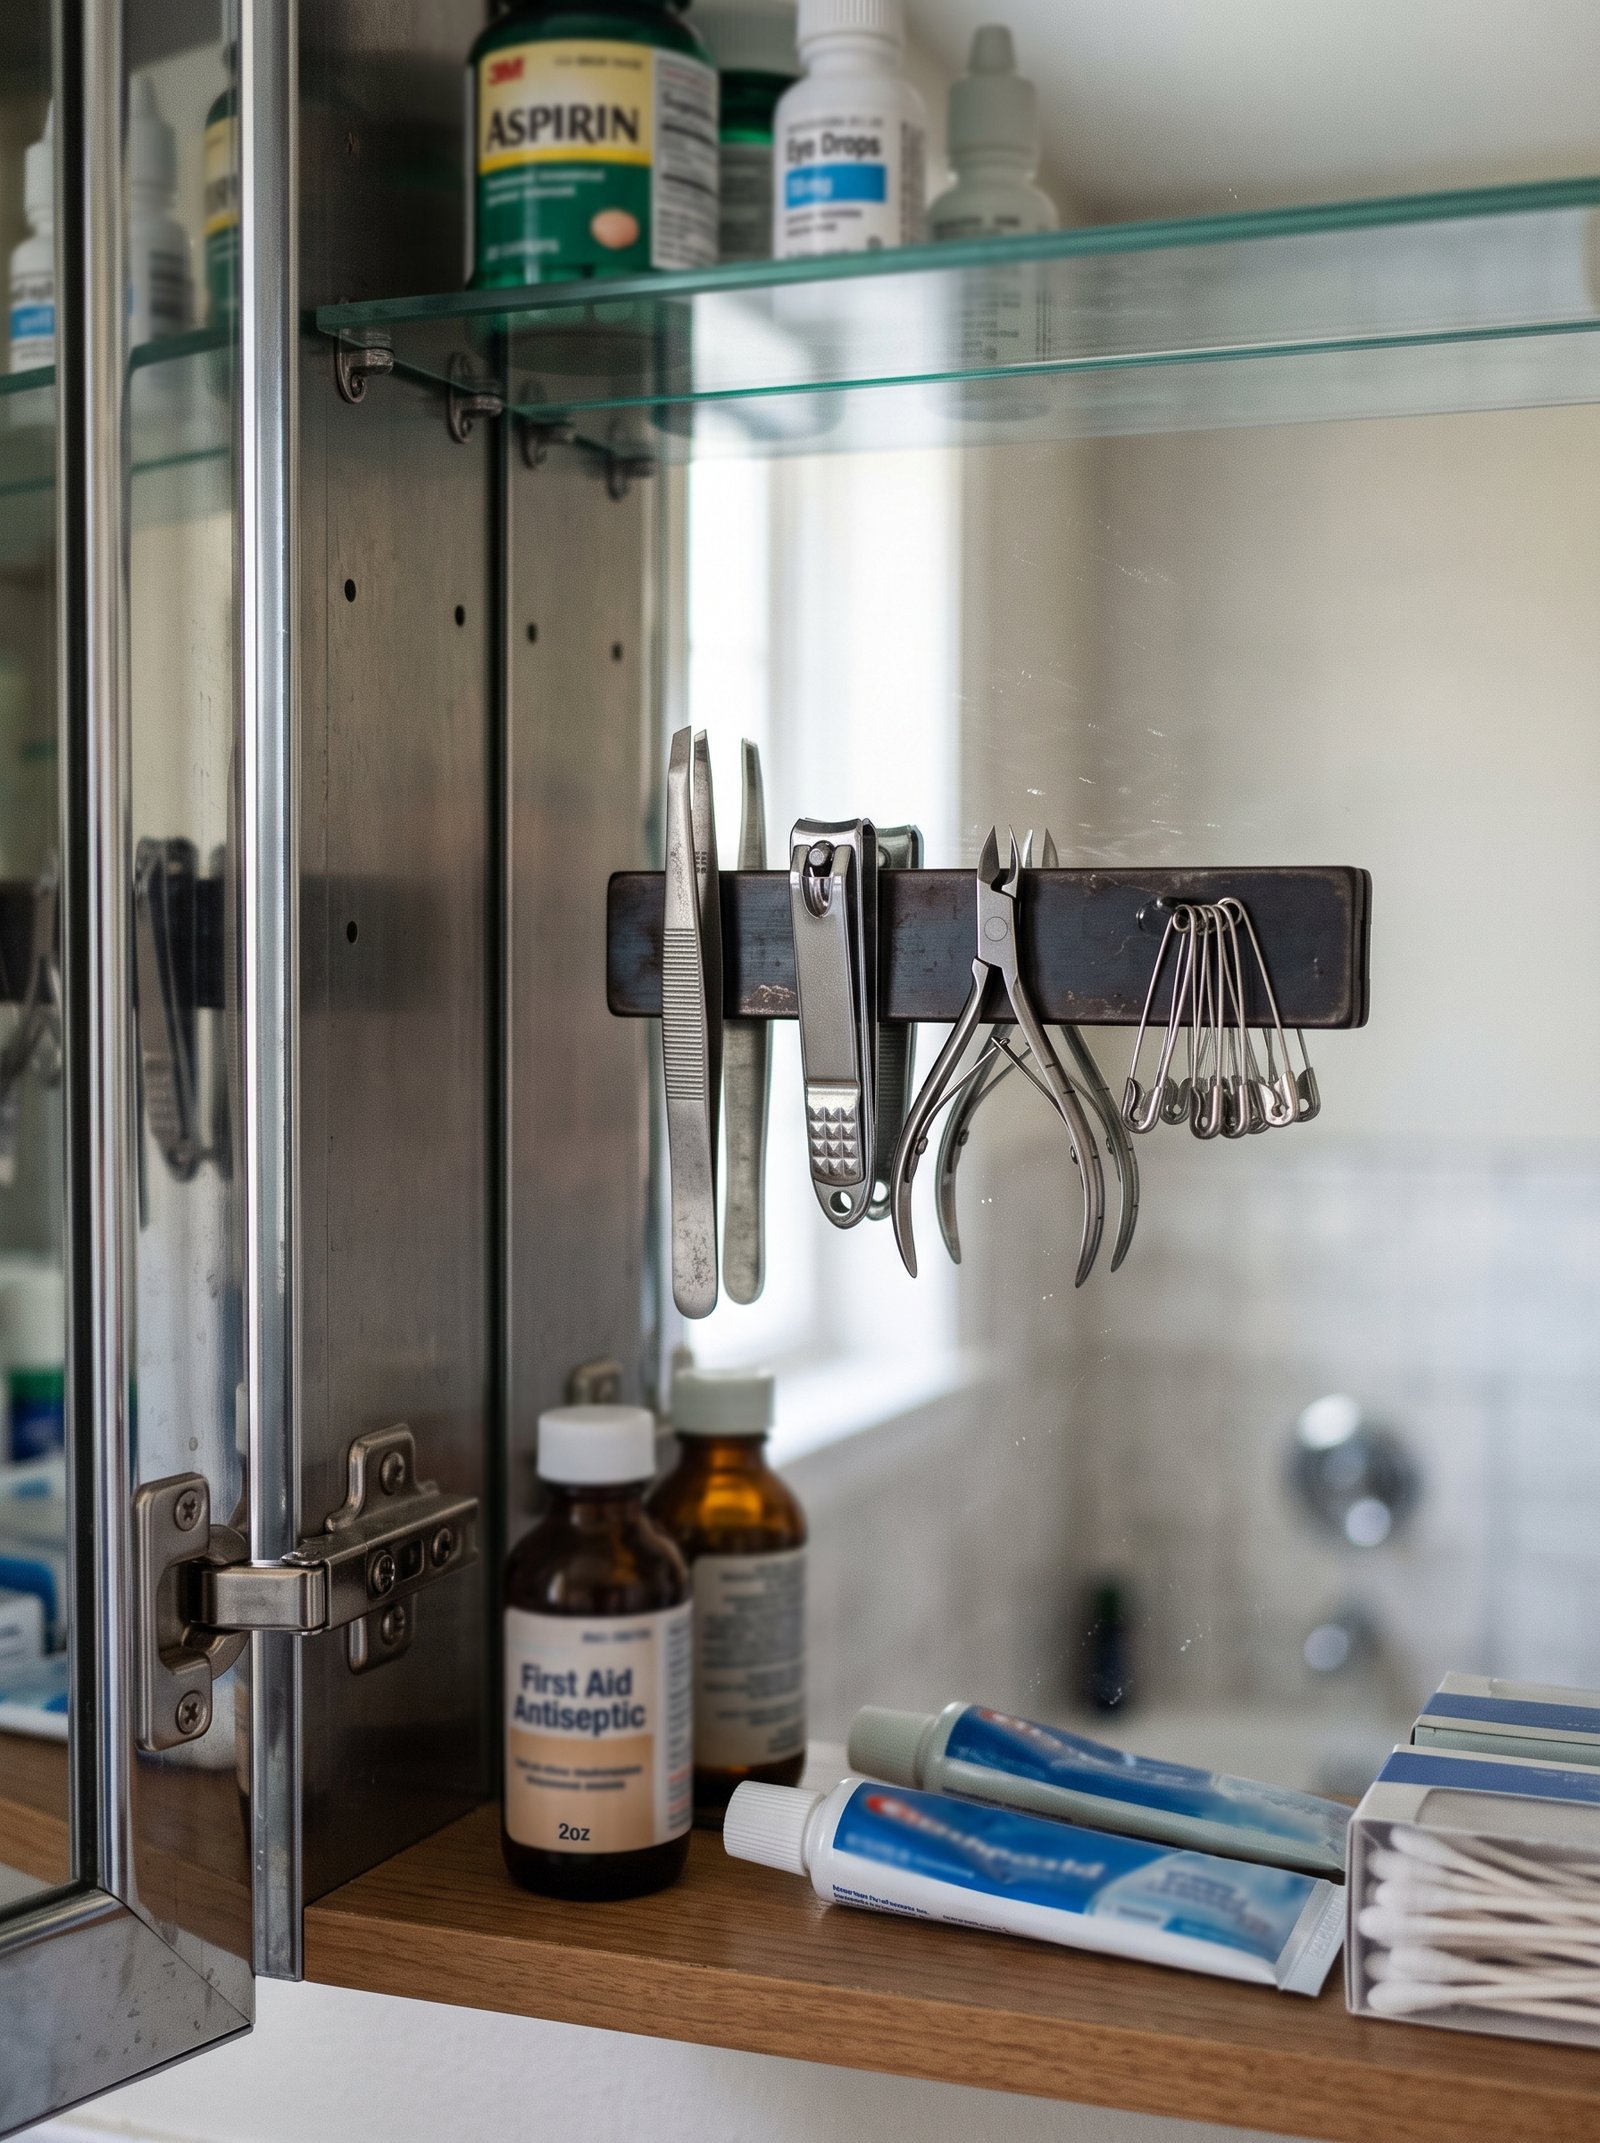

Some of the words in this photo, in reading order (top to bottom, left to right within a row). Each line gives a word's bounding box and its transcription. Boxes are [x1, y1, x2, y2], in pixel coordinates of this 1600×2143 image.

[486, 103, 639, 152] ASPIRIN
[787, 139, 815, 163] Eye
[820, 131, 881, 161] Drops
[520, 1662, 578, 1698] First
[585, 1667, 633, 1699] Aid
[514, 1695, 645, 1738] Antiseptic
[558, 1822, 591, 1842] 2oz
